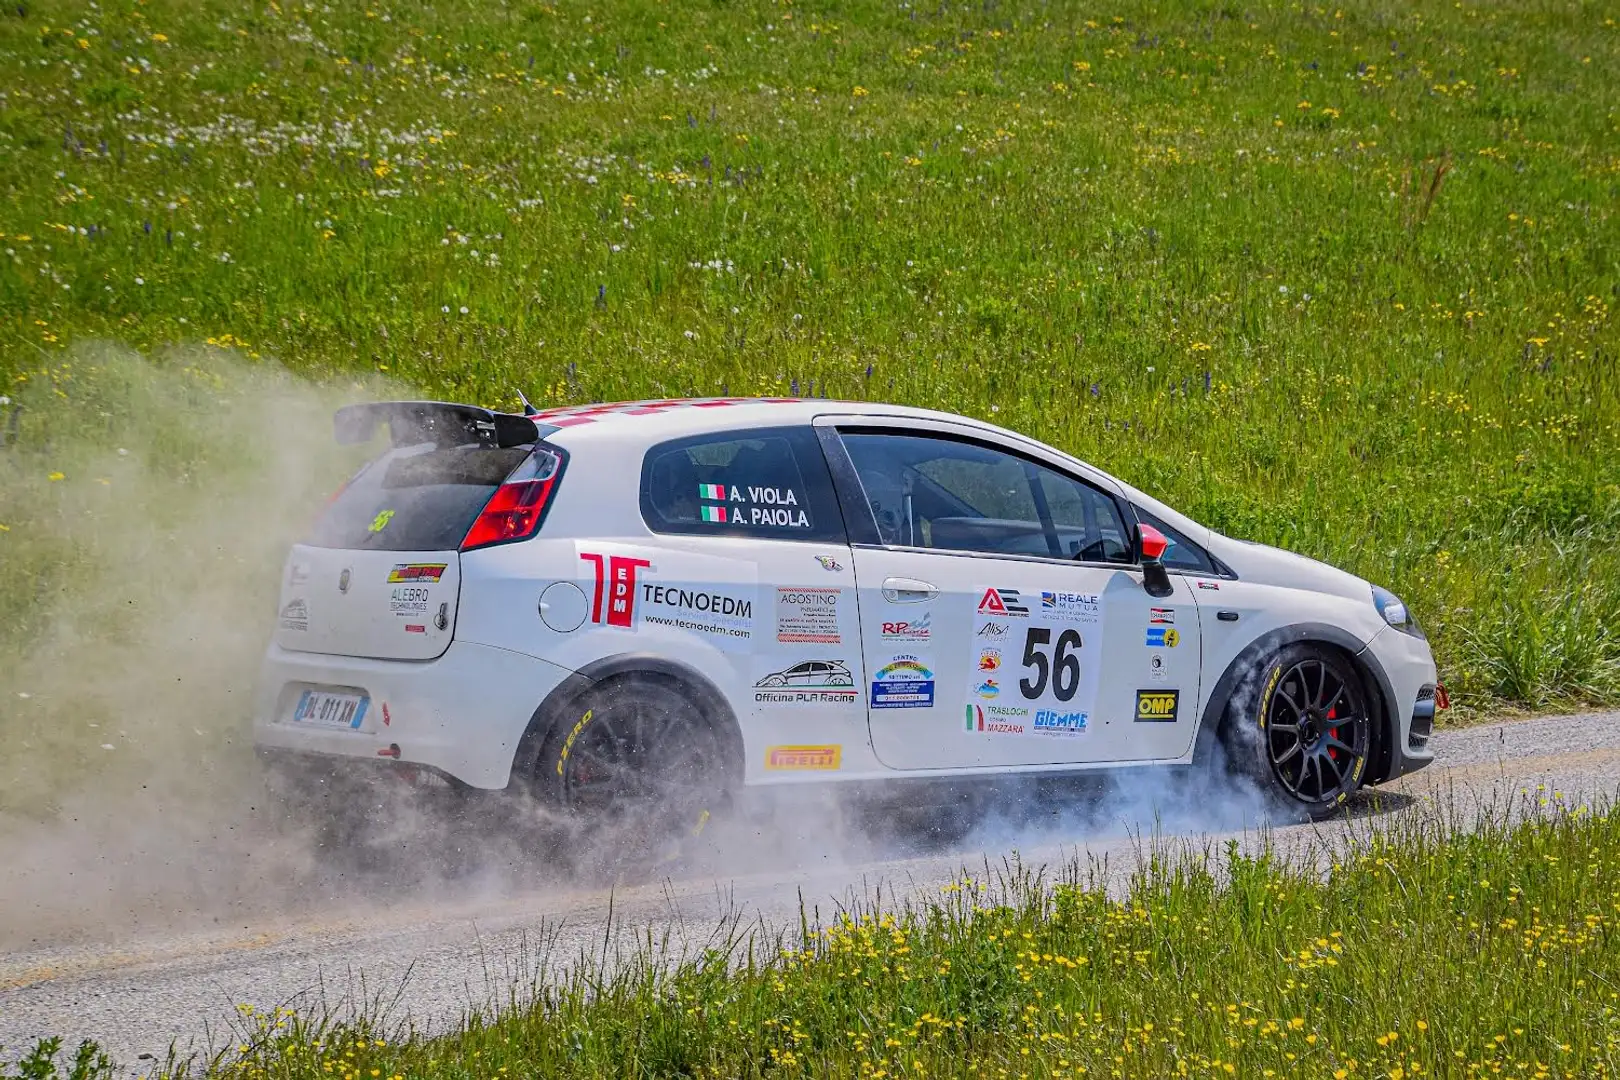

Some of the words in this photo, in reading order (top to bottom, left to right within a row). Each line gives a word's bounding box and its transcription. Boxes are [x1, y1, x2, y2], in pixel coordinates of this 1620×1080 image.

[730, 485, 746, 502] A.
[747, 486, 798, 505] VIOLA
[732, 507, 748, 524] A.
[751, 508, 810, 527] PAIOLA
[391, 588, 429, 602] ALEBRO
[613, 567, 627, 613] EDM
[780, 593, 836, 605] AGOSTINO
[1058, 593, 1099, 605] REALE
[643, 584, 752, 619] TECNOEDM
[1059, 602, 1099, 612] MUTUA
[645, 615, 751, 639] www.tecnoedm.com
[1019, 627, 1083, 703] 56
[755, 693, 793, 703] Officina
[820, 693, 855, 704] Racing
[1139, 698, 1174, 714] OMP
[987, 706, 1029, 717] TRASLOCHI
[1034, 710, 1088, 728] GIEMME
[769, 748, 835, 766] PIRELLI
